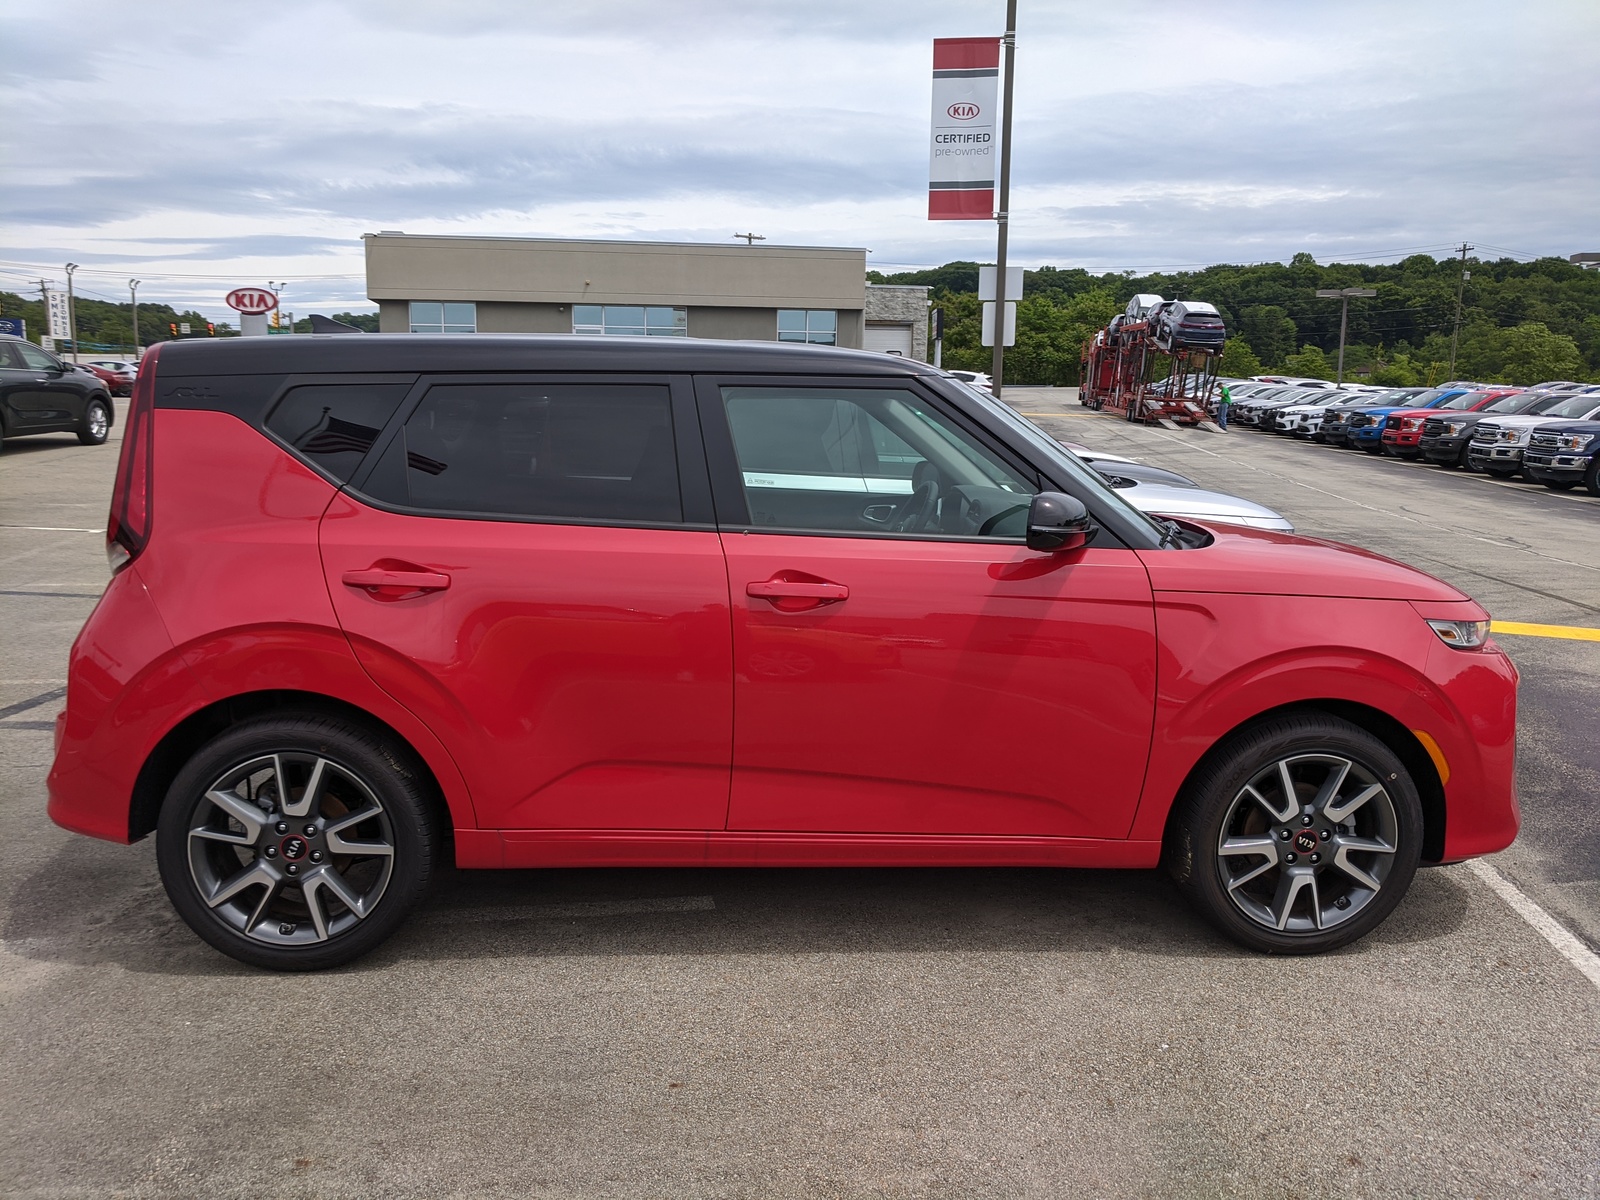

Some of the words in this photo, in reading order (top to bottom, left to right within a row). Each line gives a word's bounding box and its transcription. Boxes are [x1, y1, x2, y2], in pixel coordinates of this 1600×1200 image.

[953, 106, 975, 116] KIA
[935, 133, 991, 144] CERTIFIED
[234, 293, 269, 308] KIA
[51, 294, 60, 335] SMAIL
[286, 840, 302, 858] KIA
[1298, 836, 1315, 849] KIA
